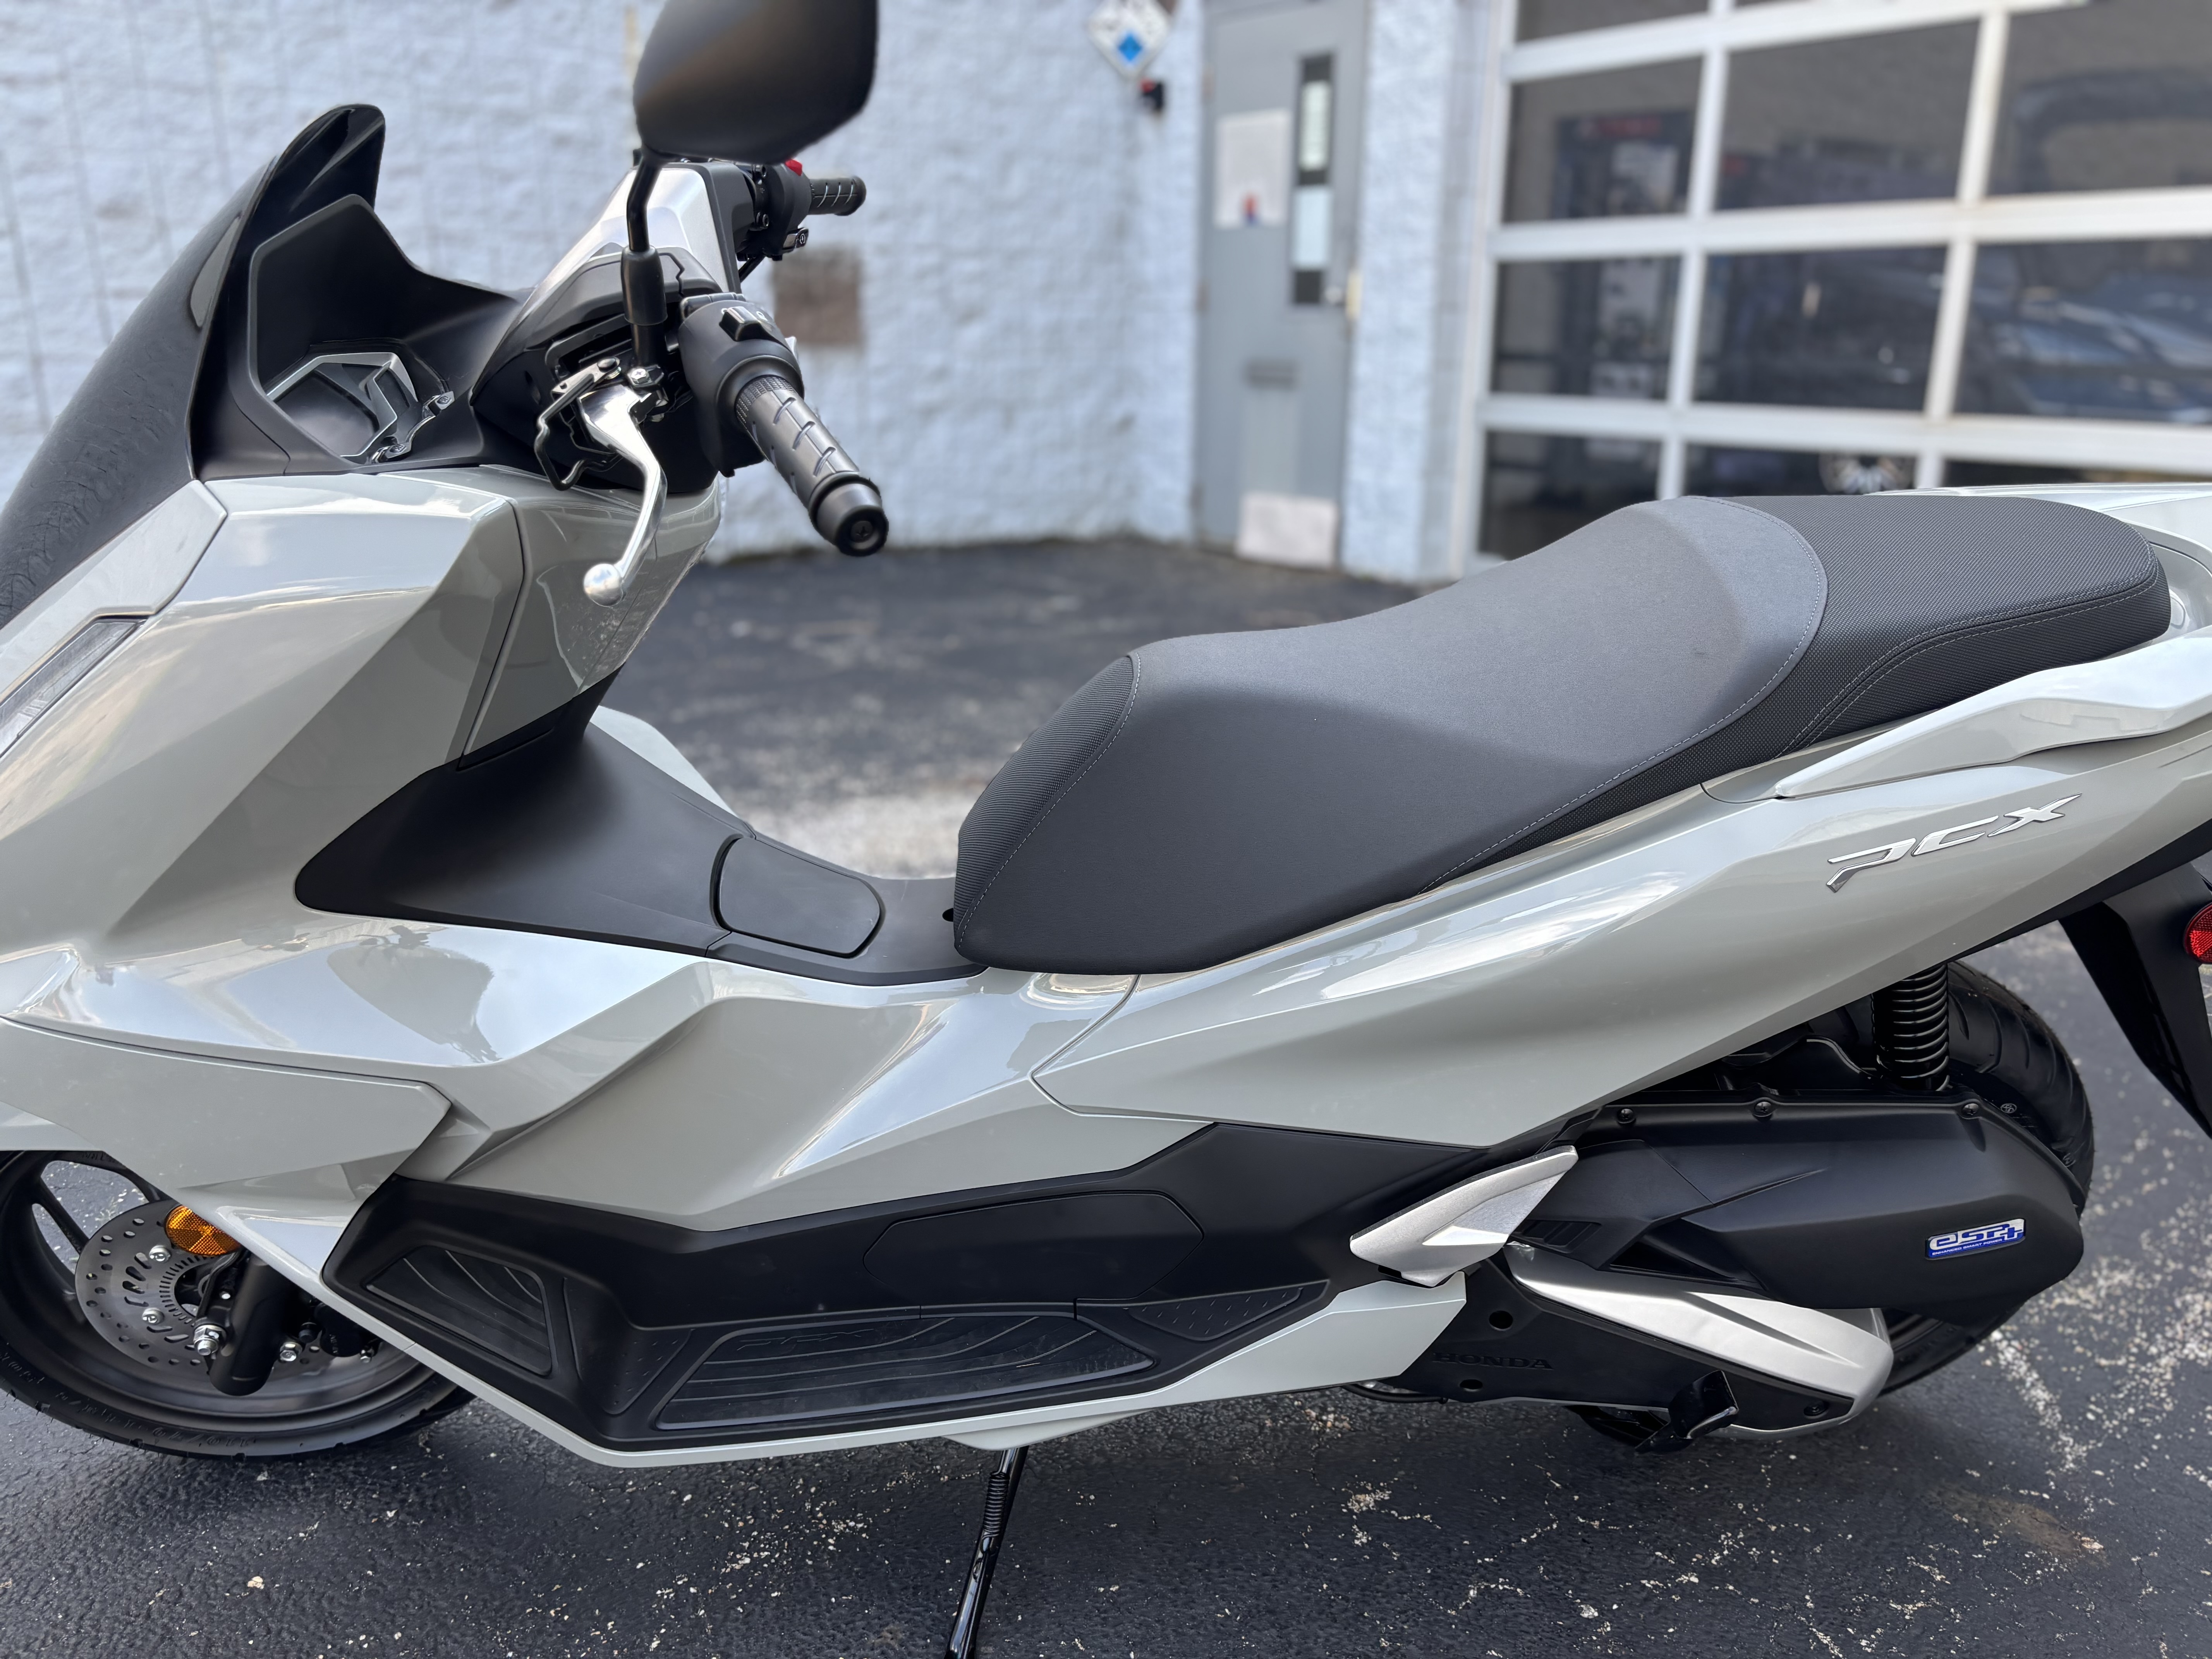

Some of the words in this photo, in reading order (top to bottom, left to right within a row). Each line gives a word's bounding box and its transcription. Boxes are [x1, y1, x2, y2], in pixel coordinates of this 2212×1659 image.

[1826, 792, 2082, 893] PCX
[1932, 1247, 1962, 1256] ENHANCED
[1432, 1353, 1554, 1370] HONDA
